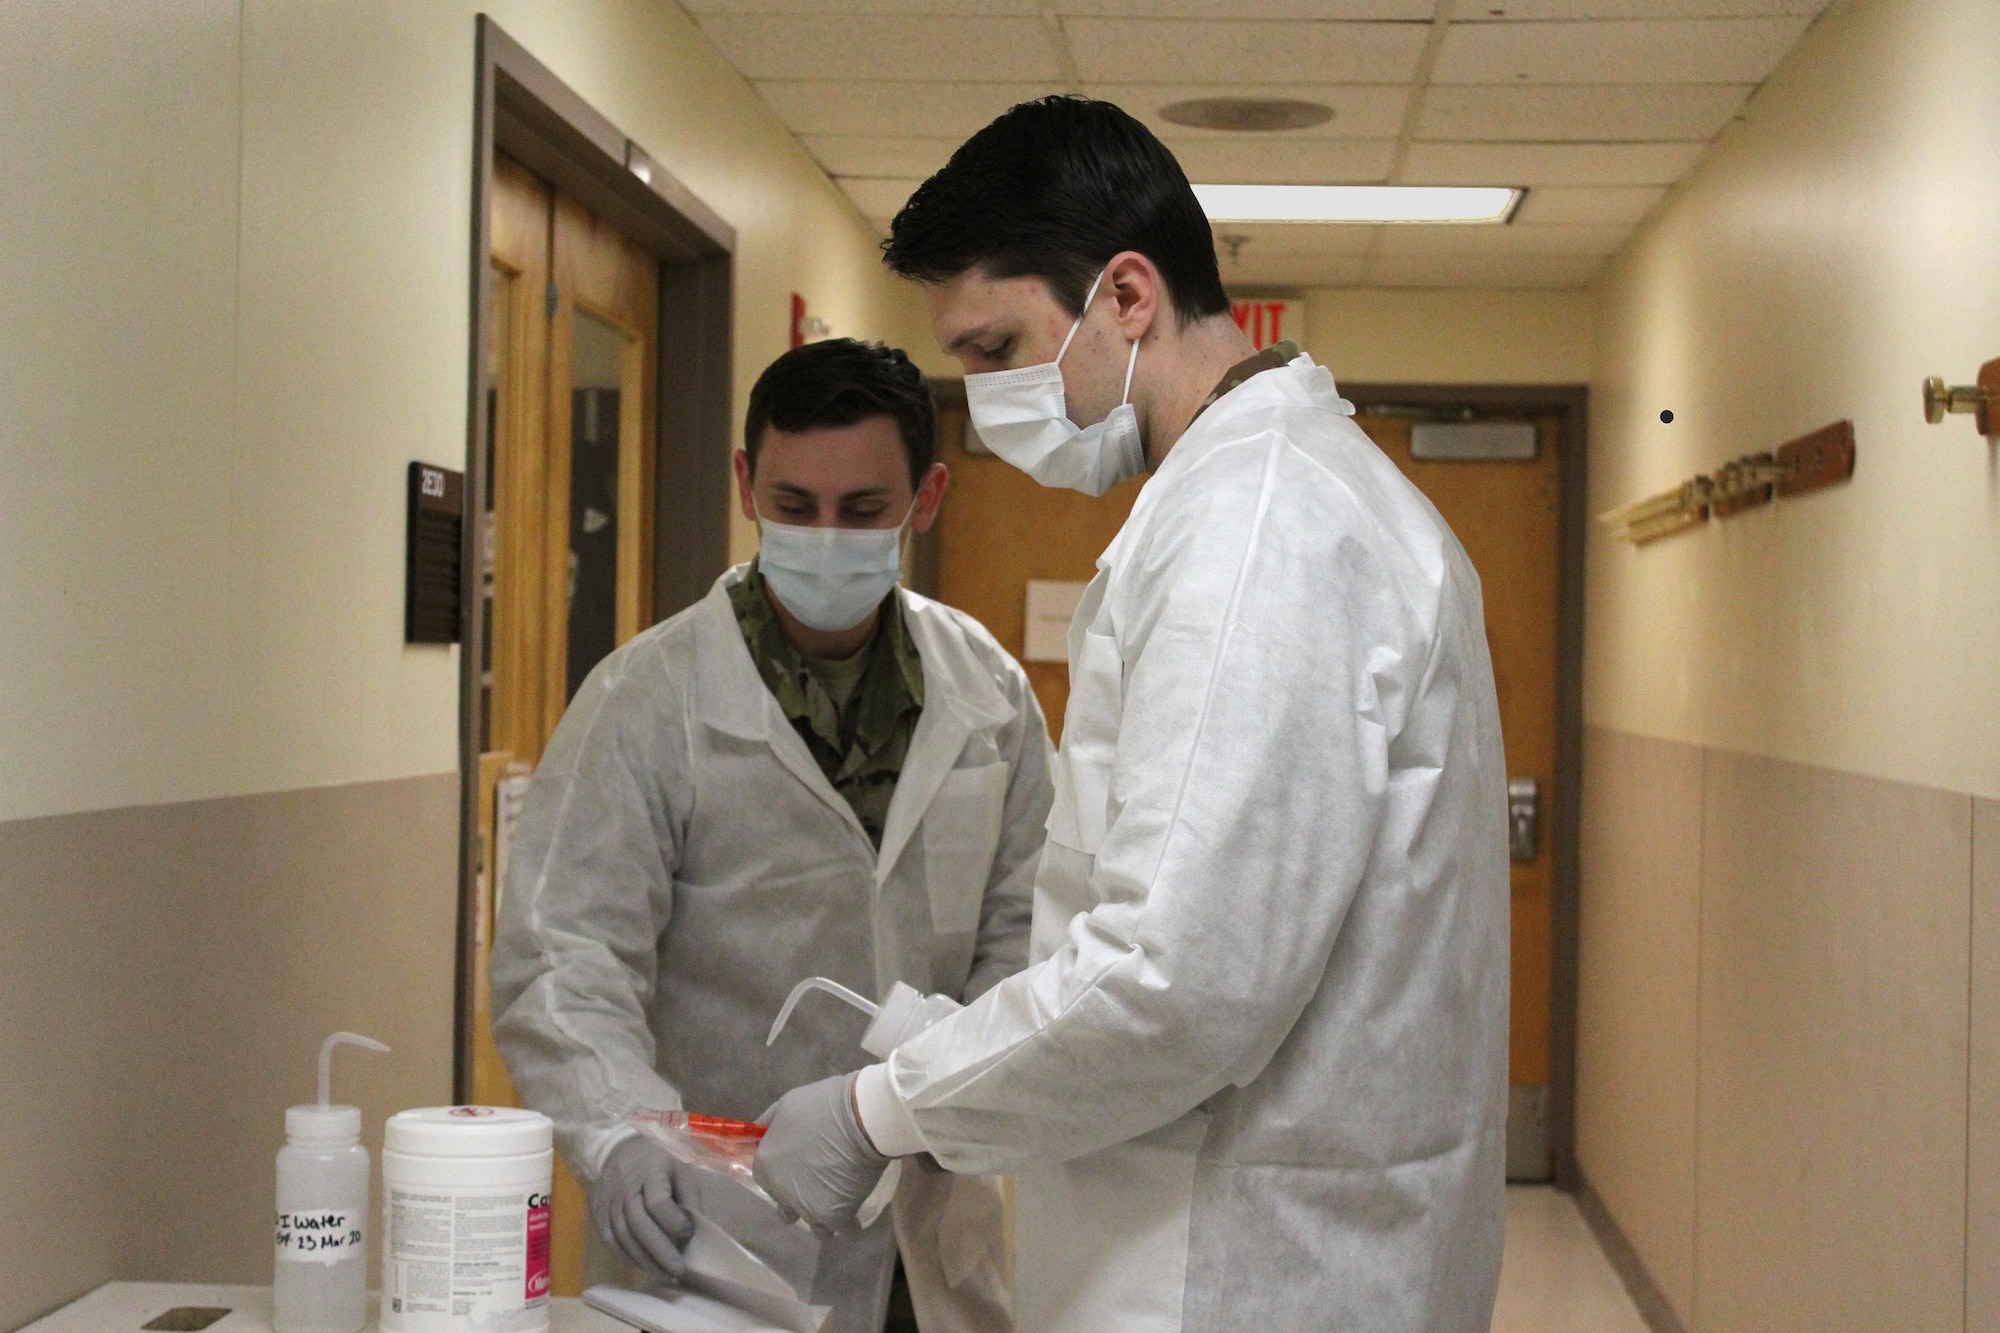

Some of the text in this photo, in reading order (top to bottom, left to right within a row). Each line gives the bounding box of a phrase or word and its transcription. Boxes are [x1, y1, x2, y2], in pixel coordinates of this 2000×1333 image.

[527, 1193, 551, 1209] Ca
[298, 1235, 317, 1251] 23
[321, 1234, 345, 1249] Mar
[349, 1230, 361, 1247] 20
